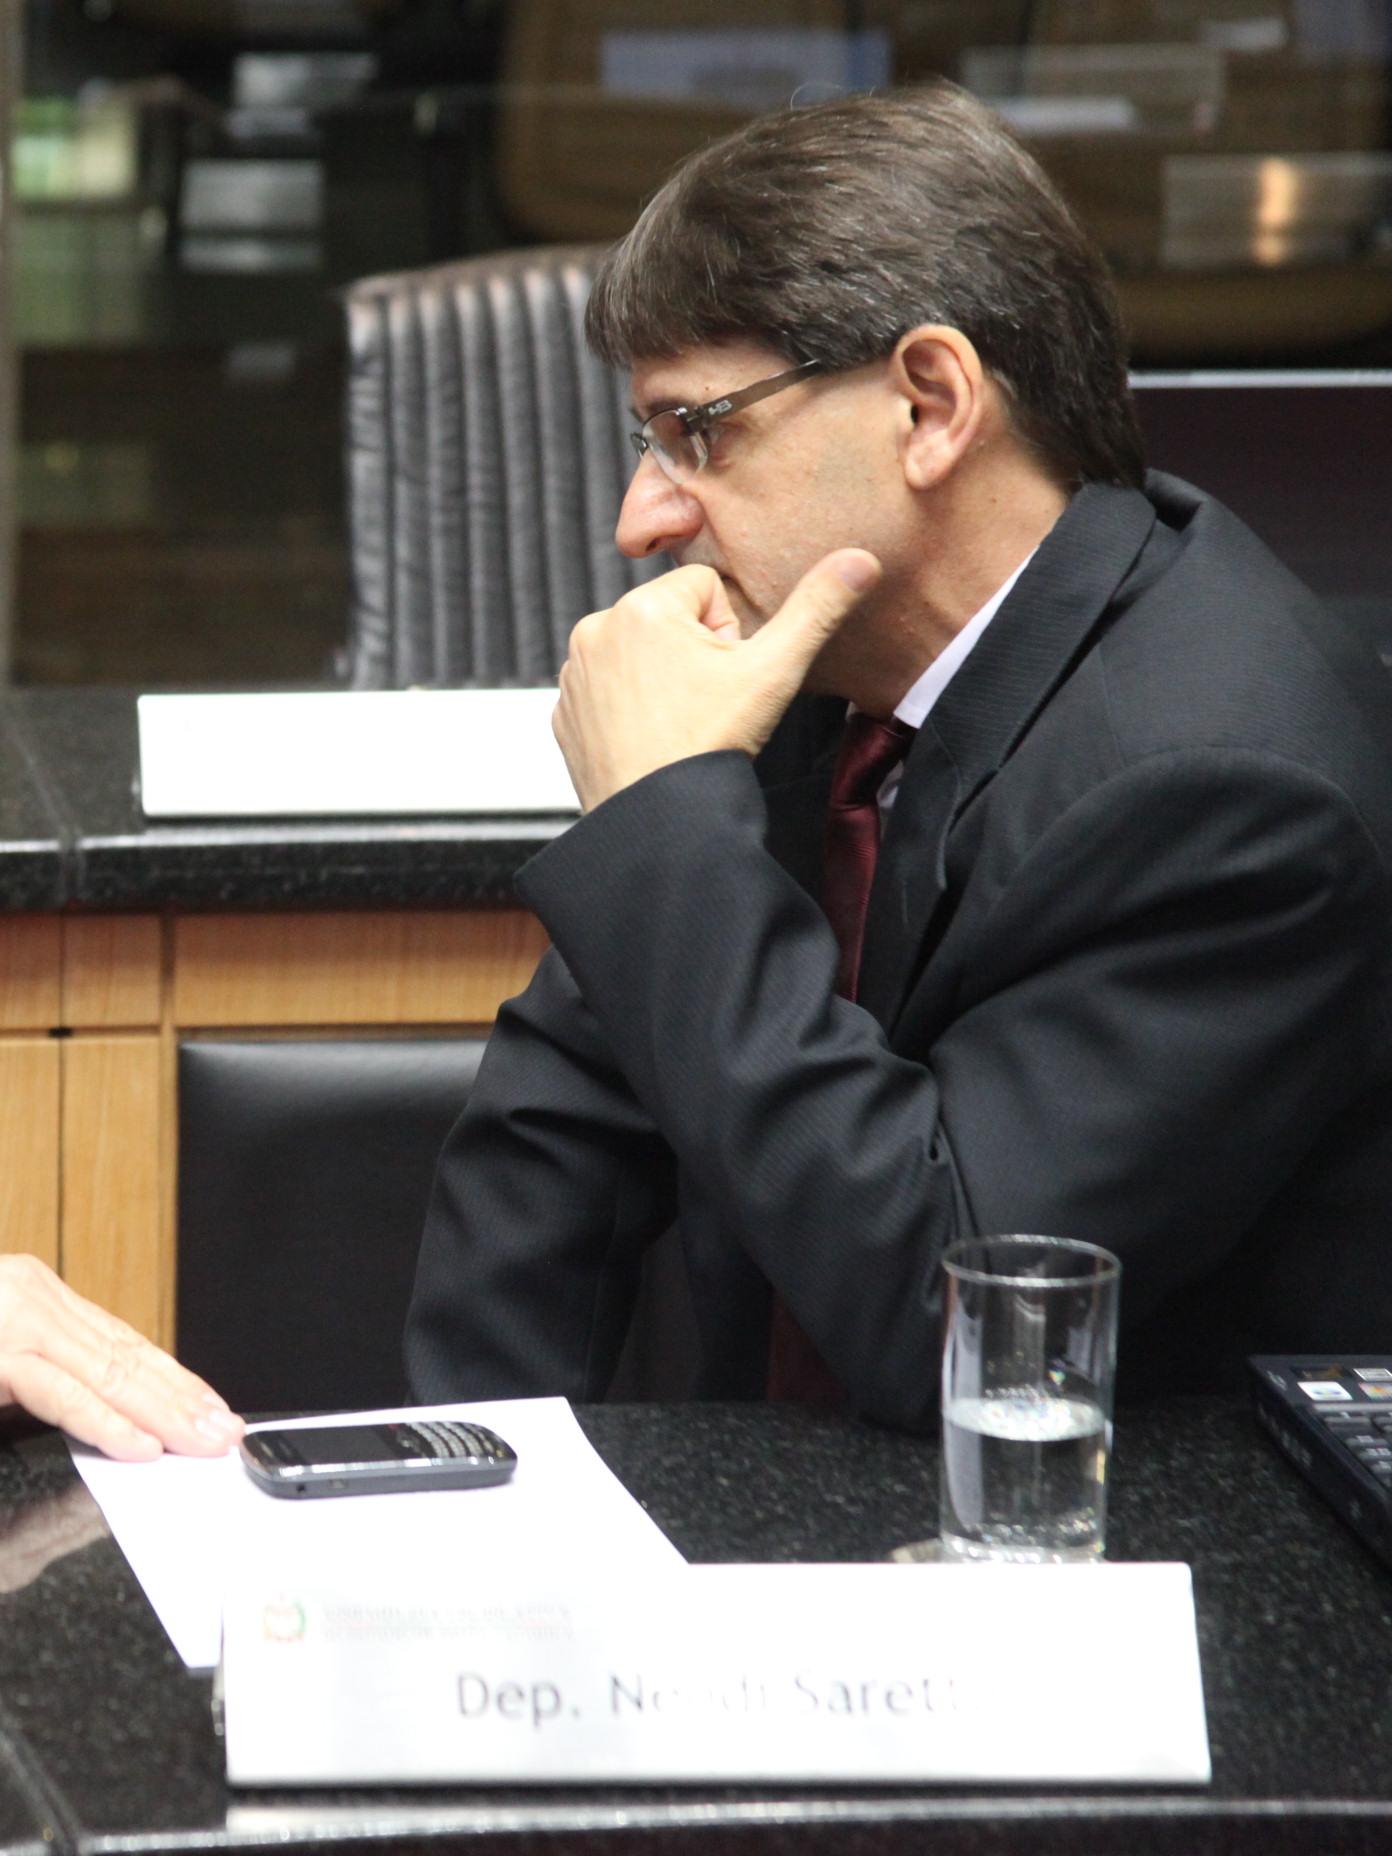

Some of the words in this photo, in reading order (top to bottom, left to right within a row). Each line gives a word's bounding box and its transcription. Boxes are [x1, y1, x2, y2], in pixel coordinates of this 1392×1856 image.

[455, 1671, 582, 1731] Dep.
[609, 1671, 769, 1720] Nedi
[791, 1669, 995, 1720] Sarett
